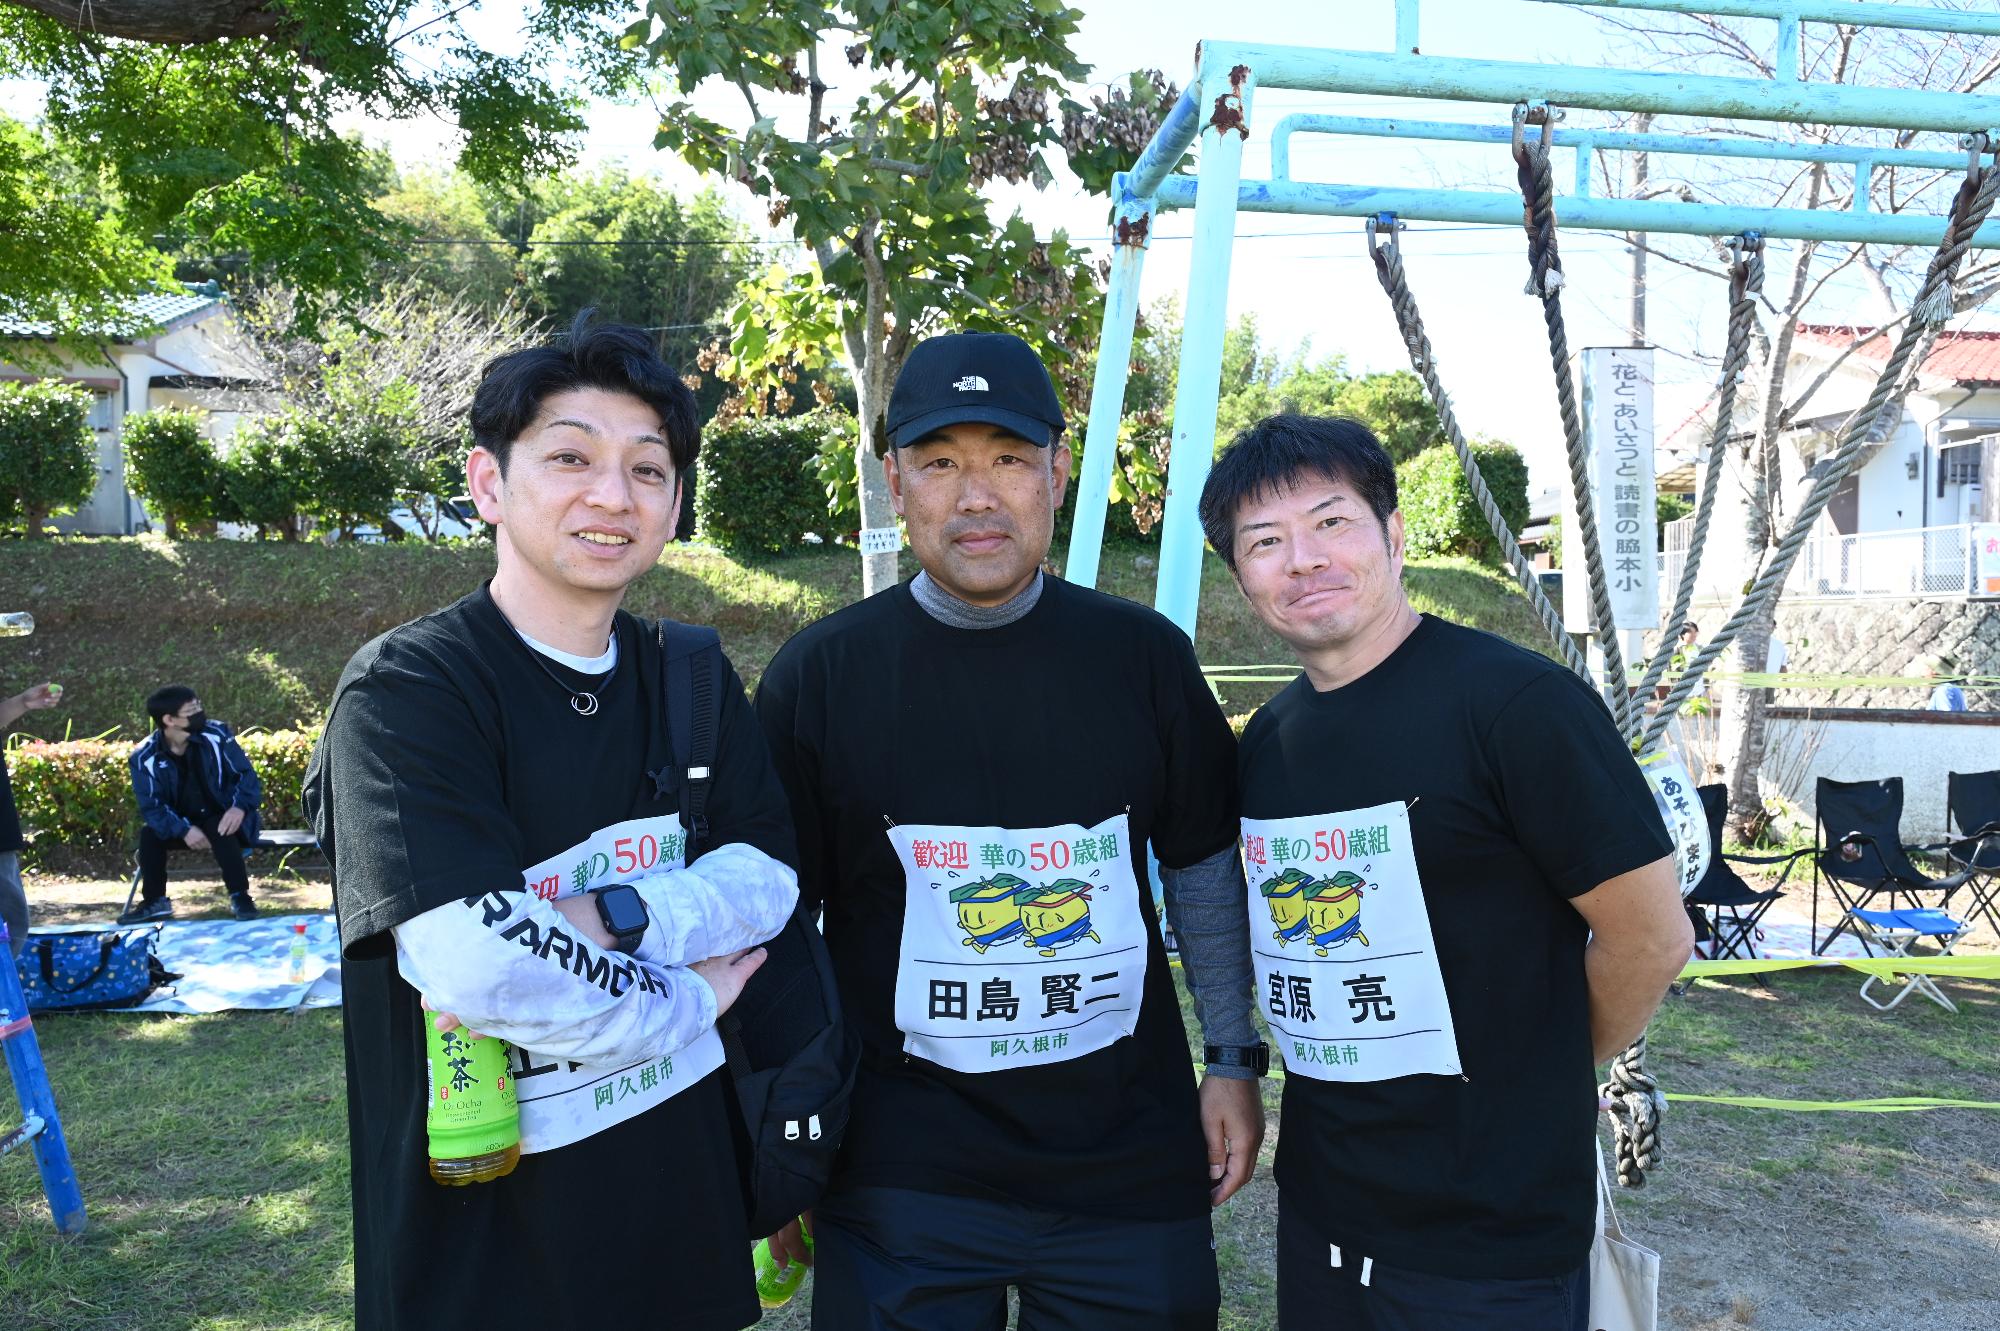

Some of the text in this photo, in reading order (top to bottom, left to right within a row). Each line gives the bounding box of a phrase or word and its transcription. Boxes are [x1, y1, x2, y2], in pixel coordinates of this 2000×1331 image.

[912, 833, 1120, 872] 歓迎 華の50歳組
[1270, 825, 1391, 865] 華の50歳組
[929, 971, 1121, 1021] 田島 賢二
[1268, 971, 1396, 1024] 宮原 亮
[991, 1033, 1069, 1057] 阿久根市
[1293, 1041, 1359, 1066] 阿久根市
[594, 1056, 674, 1111] 阿久根市
